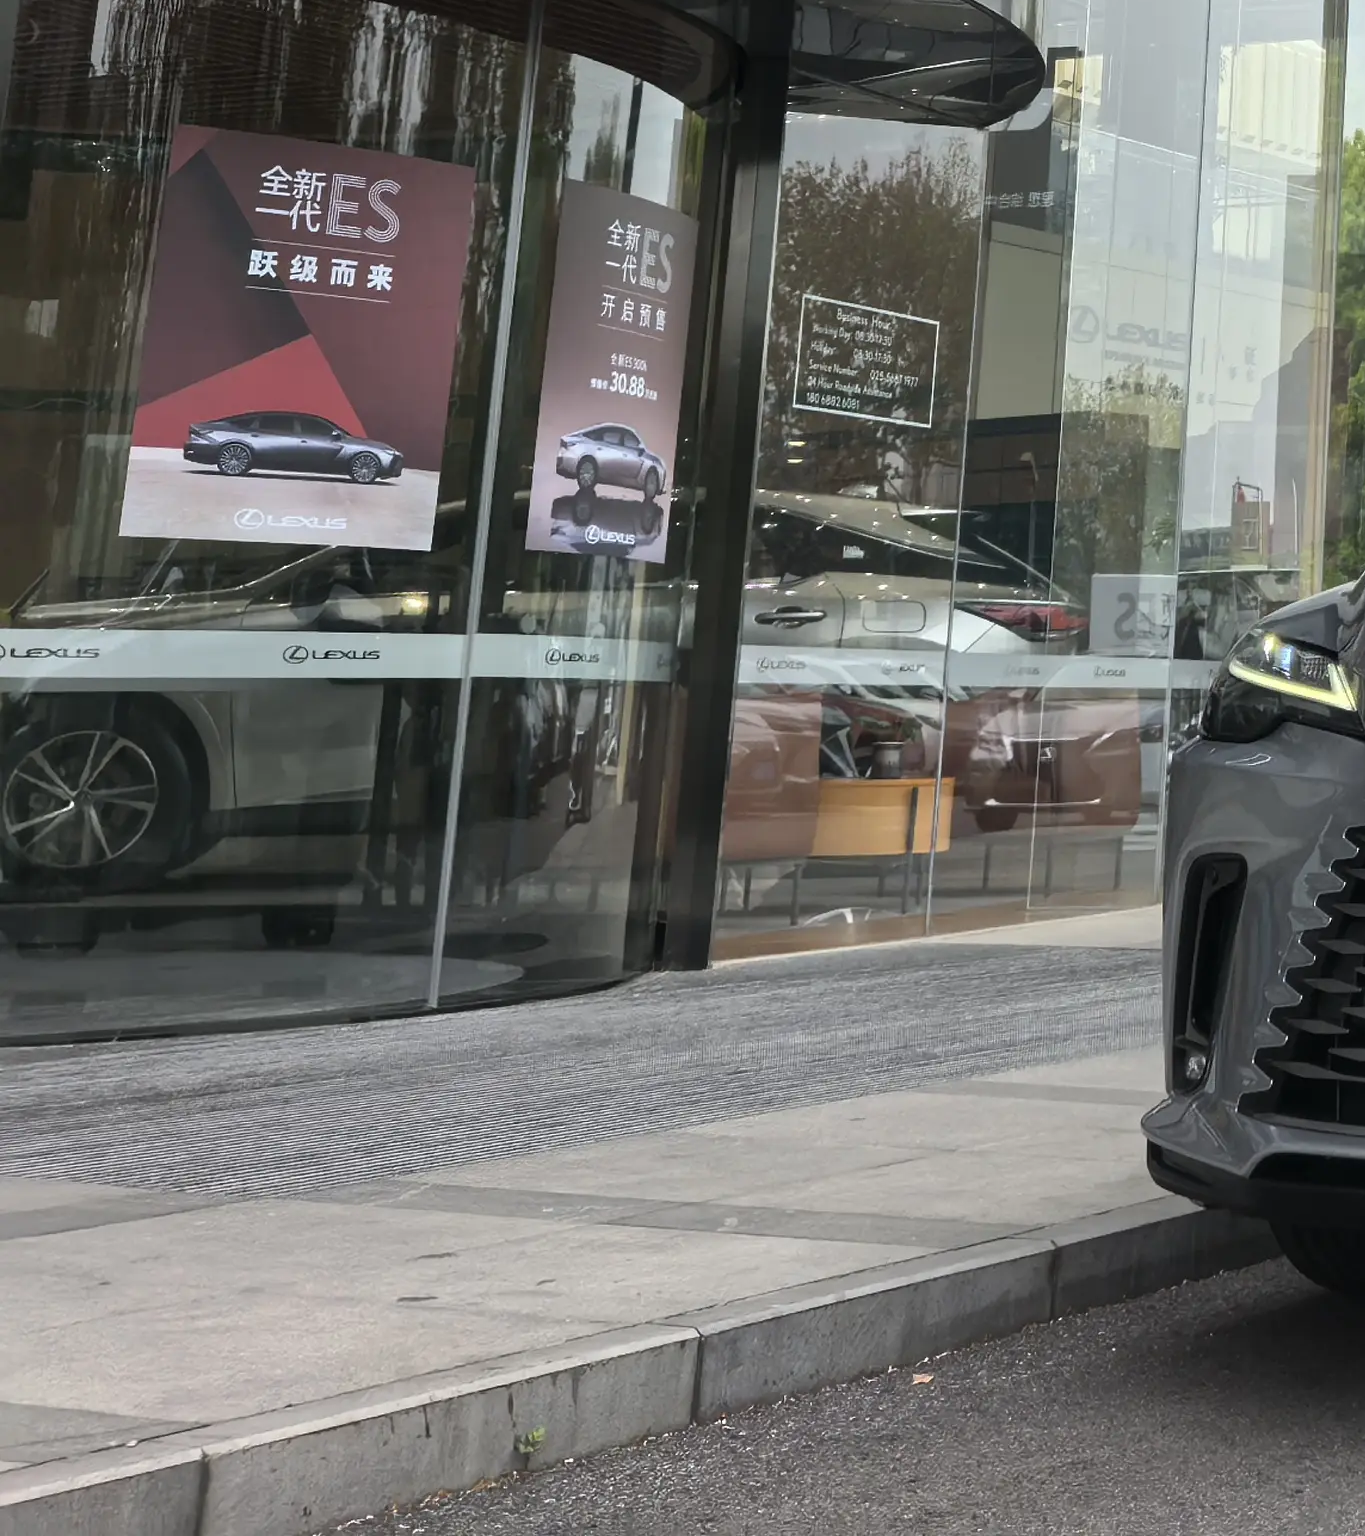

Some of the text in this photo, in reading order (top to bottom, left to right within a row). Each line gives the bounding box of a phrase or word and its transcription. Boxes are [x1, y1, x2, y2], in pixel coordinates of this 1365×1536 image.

[258, 165, 327, 202] 全新
[255, 200, 322, 232] 一代
[325, 173, 402, 243] ES
[607, 219, 642, 253] 全新
[247, 249, 394, 292] 跃级而来
[605, 254, 638, 285] 一代
[639, 227, 675, 294] ES
[600, 293, 668, 332] 开启预售
[609, 370, 646, 398] 30.88
[266, 514, 348, 530] LEXUS
[600, 528, 636, 545] LEXUS
[10, 647, 100, 659] LEXUS
[312, 649, 381, 660] LEXUS
[561, 652, 600, 663] LEXUS
